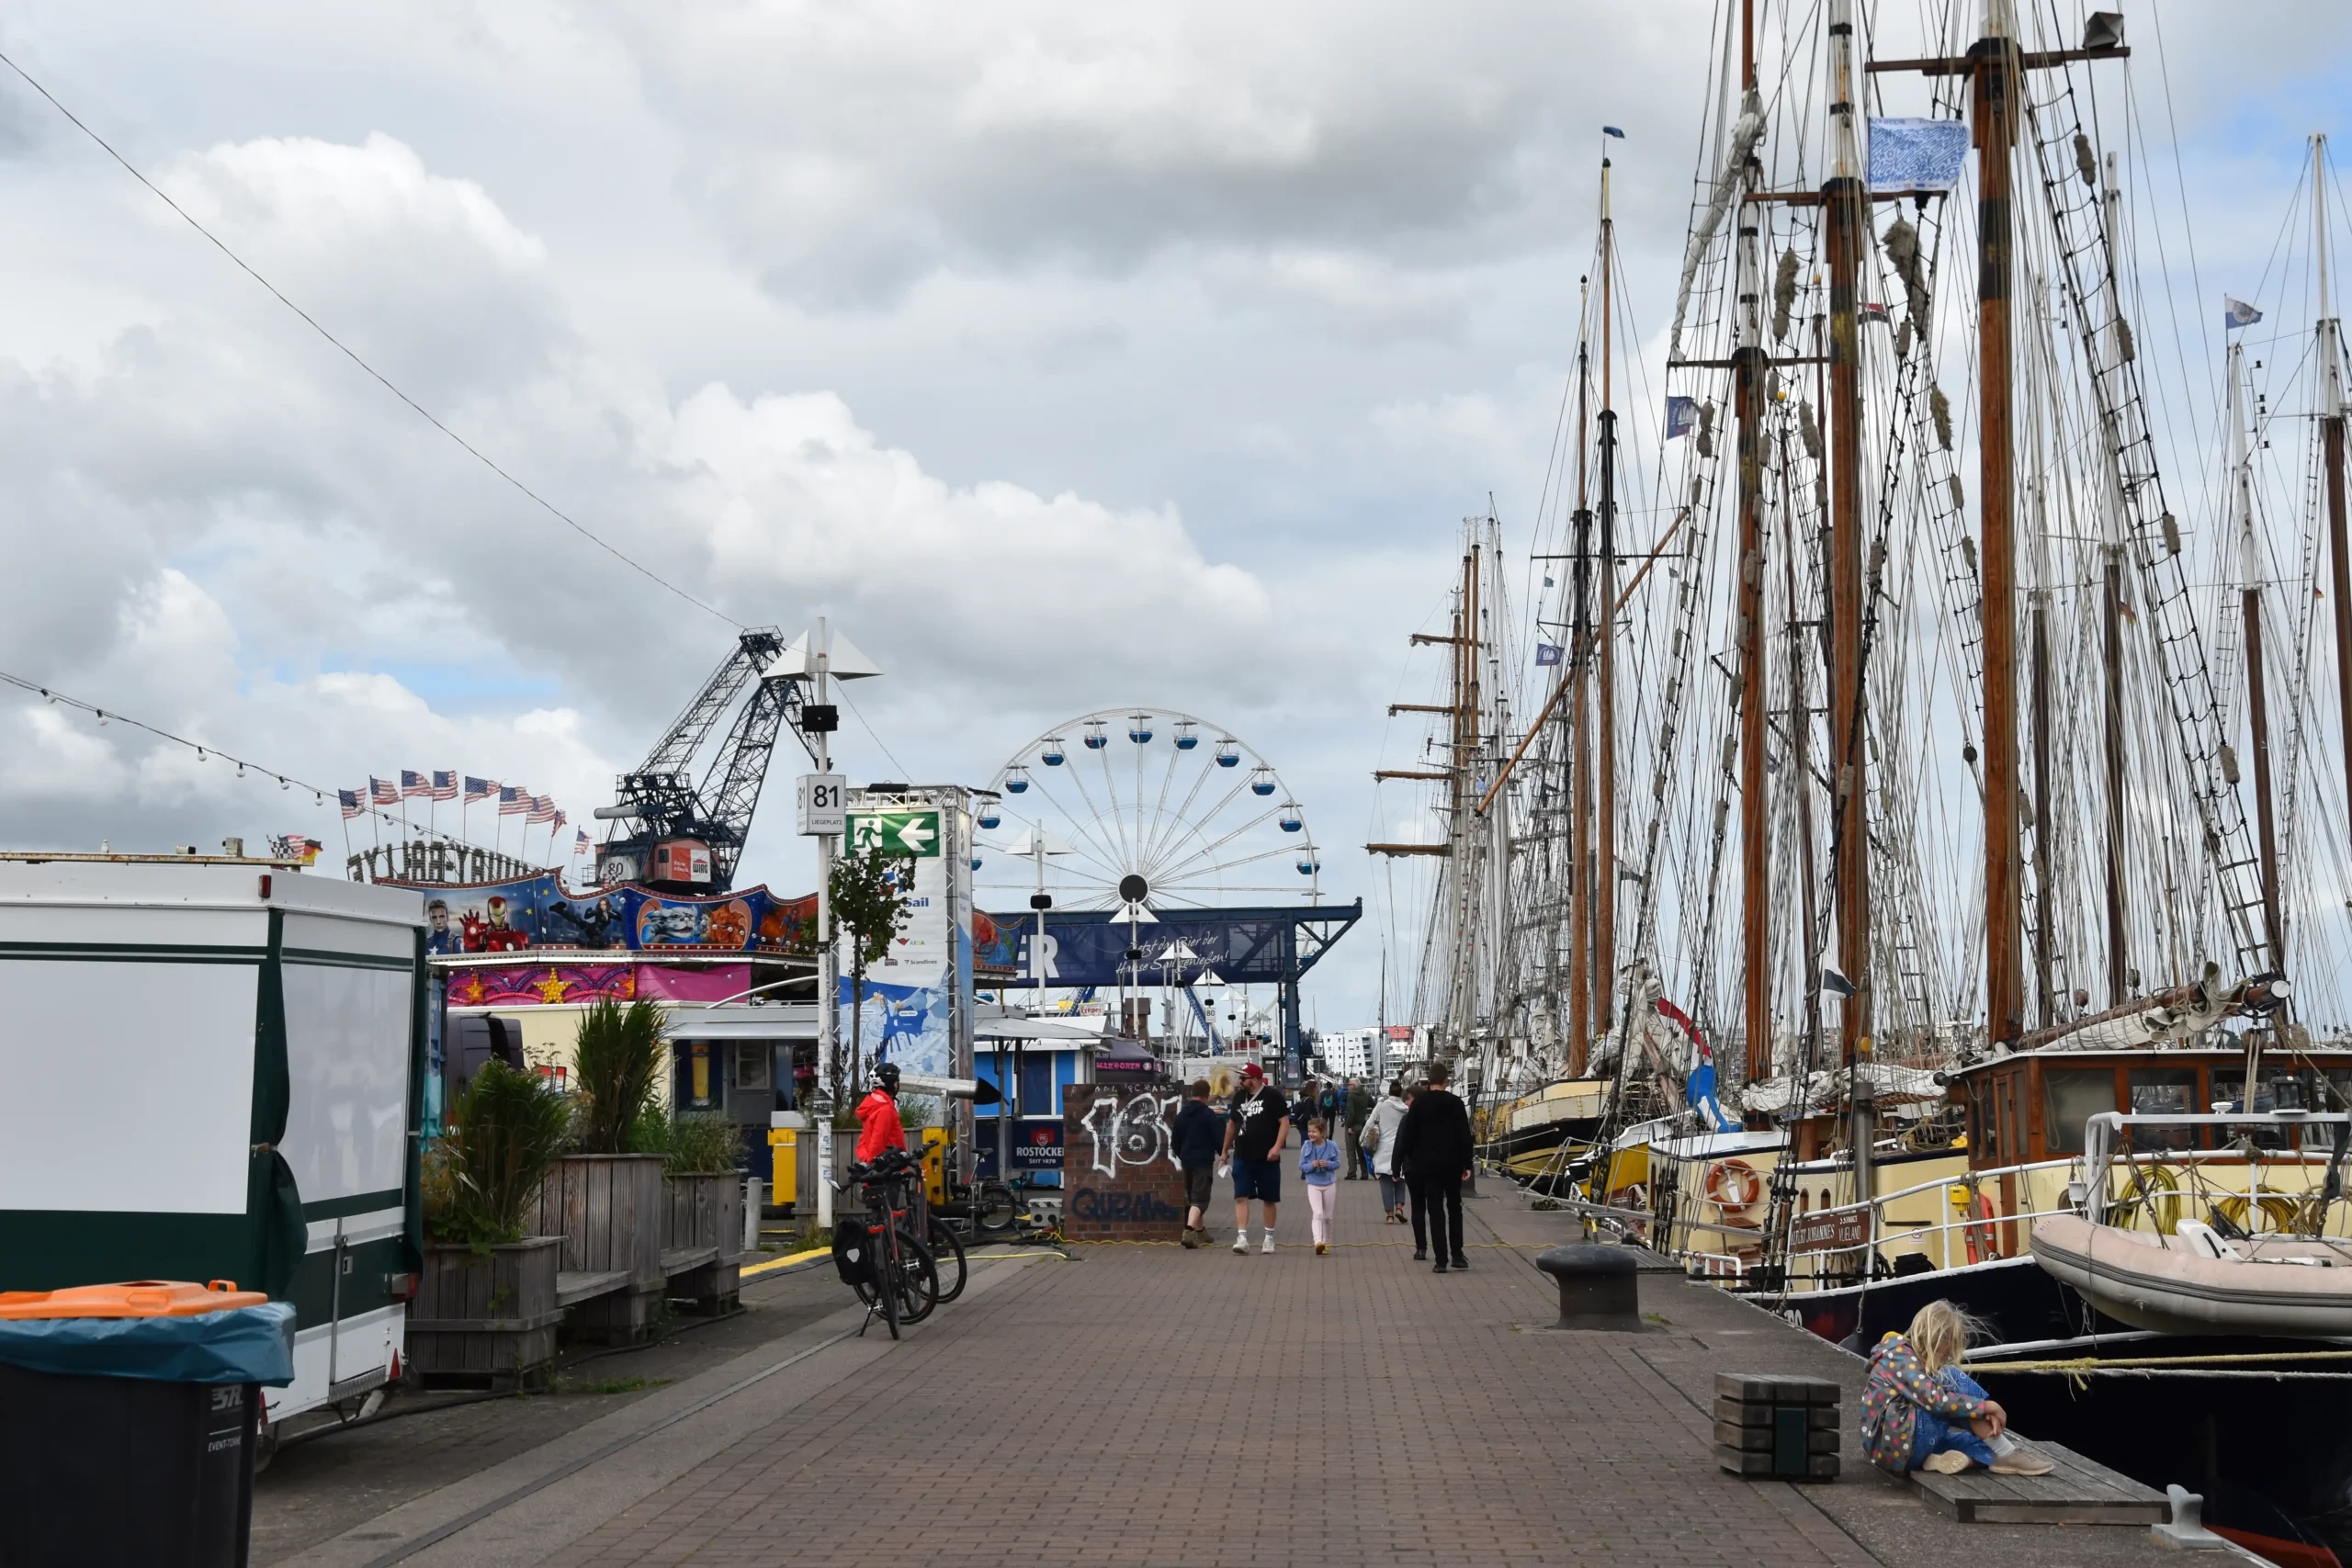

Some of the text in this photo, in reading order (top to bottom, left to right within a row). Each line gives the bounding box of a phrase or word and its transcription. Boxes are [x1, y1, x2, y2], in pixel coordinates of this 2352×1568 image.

[797, 785, 806, 809] 81
[813, 784, 838, 807] 81
[608, 862, 624, 876] 80
[692, 863, 708, 874] WIRO
[906, 897, 929, 908] Sail
[1179, 936, 1202, 948] Bier
[1203, 931, 1219, 945] der
[1150, 958, 1175, 970] Sail
